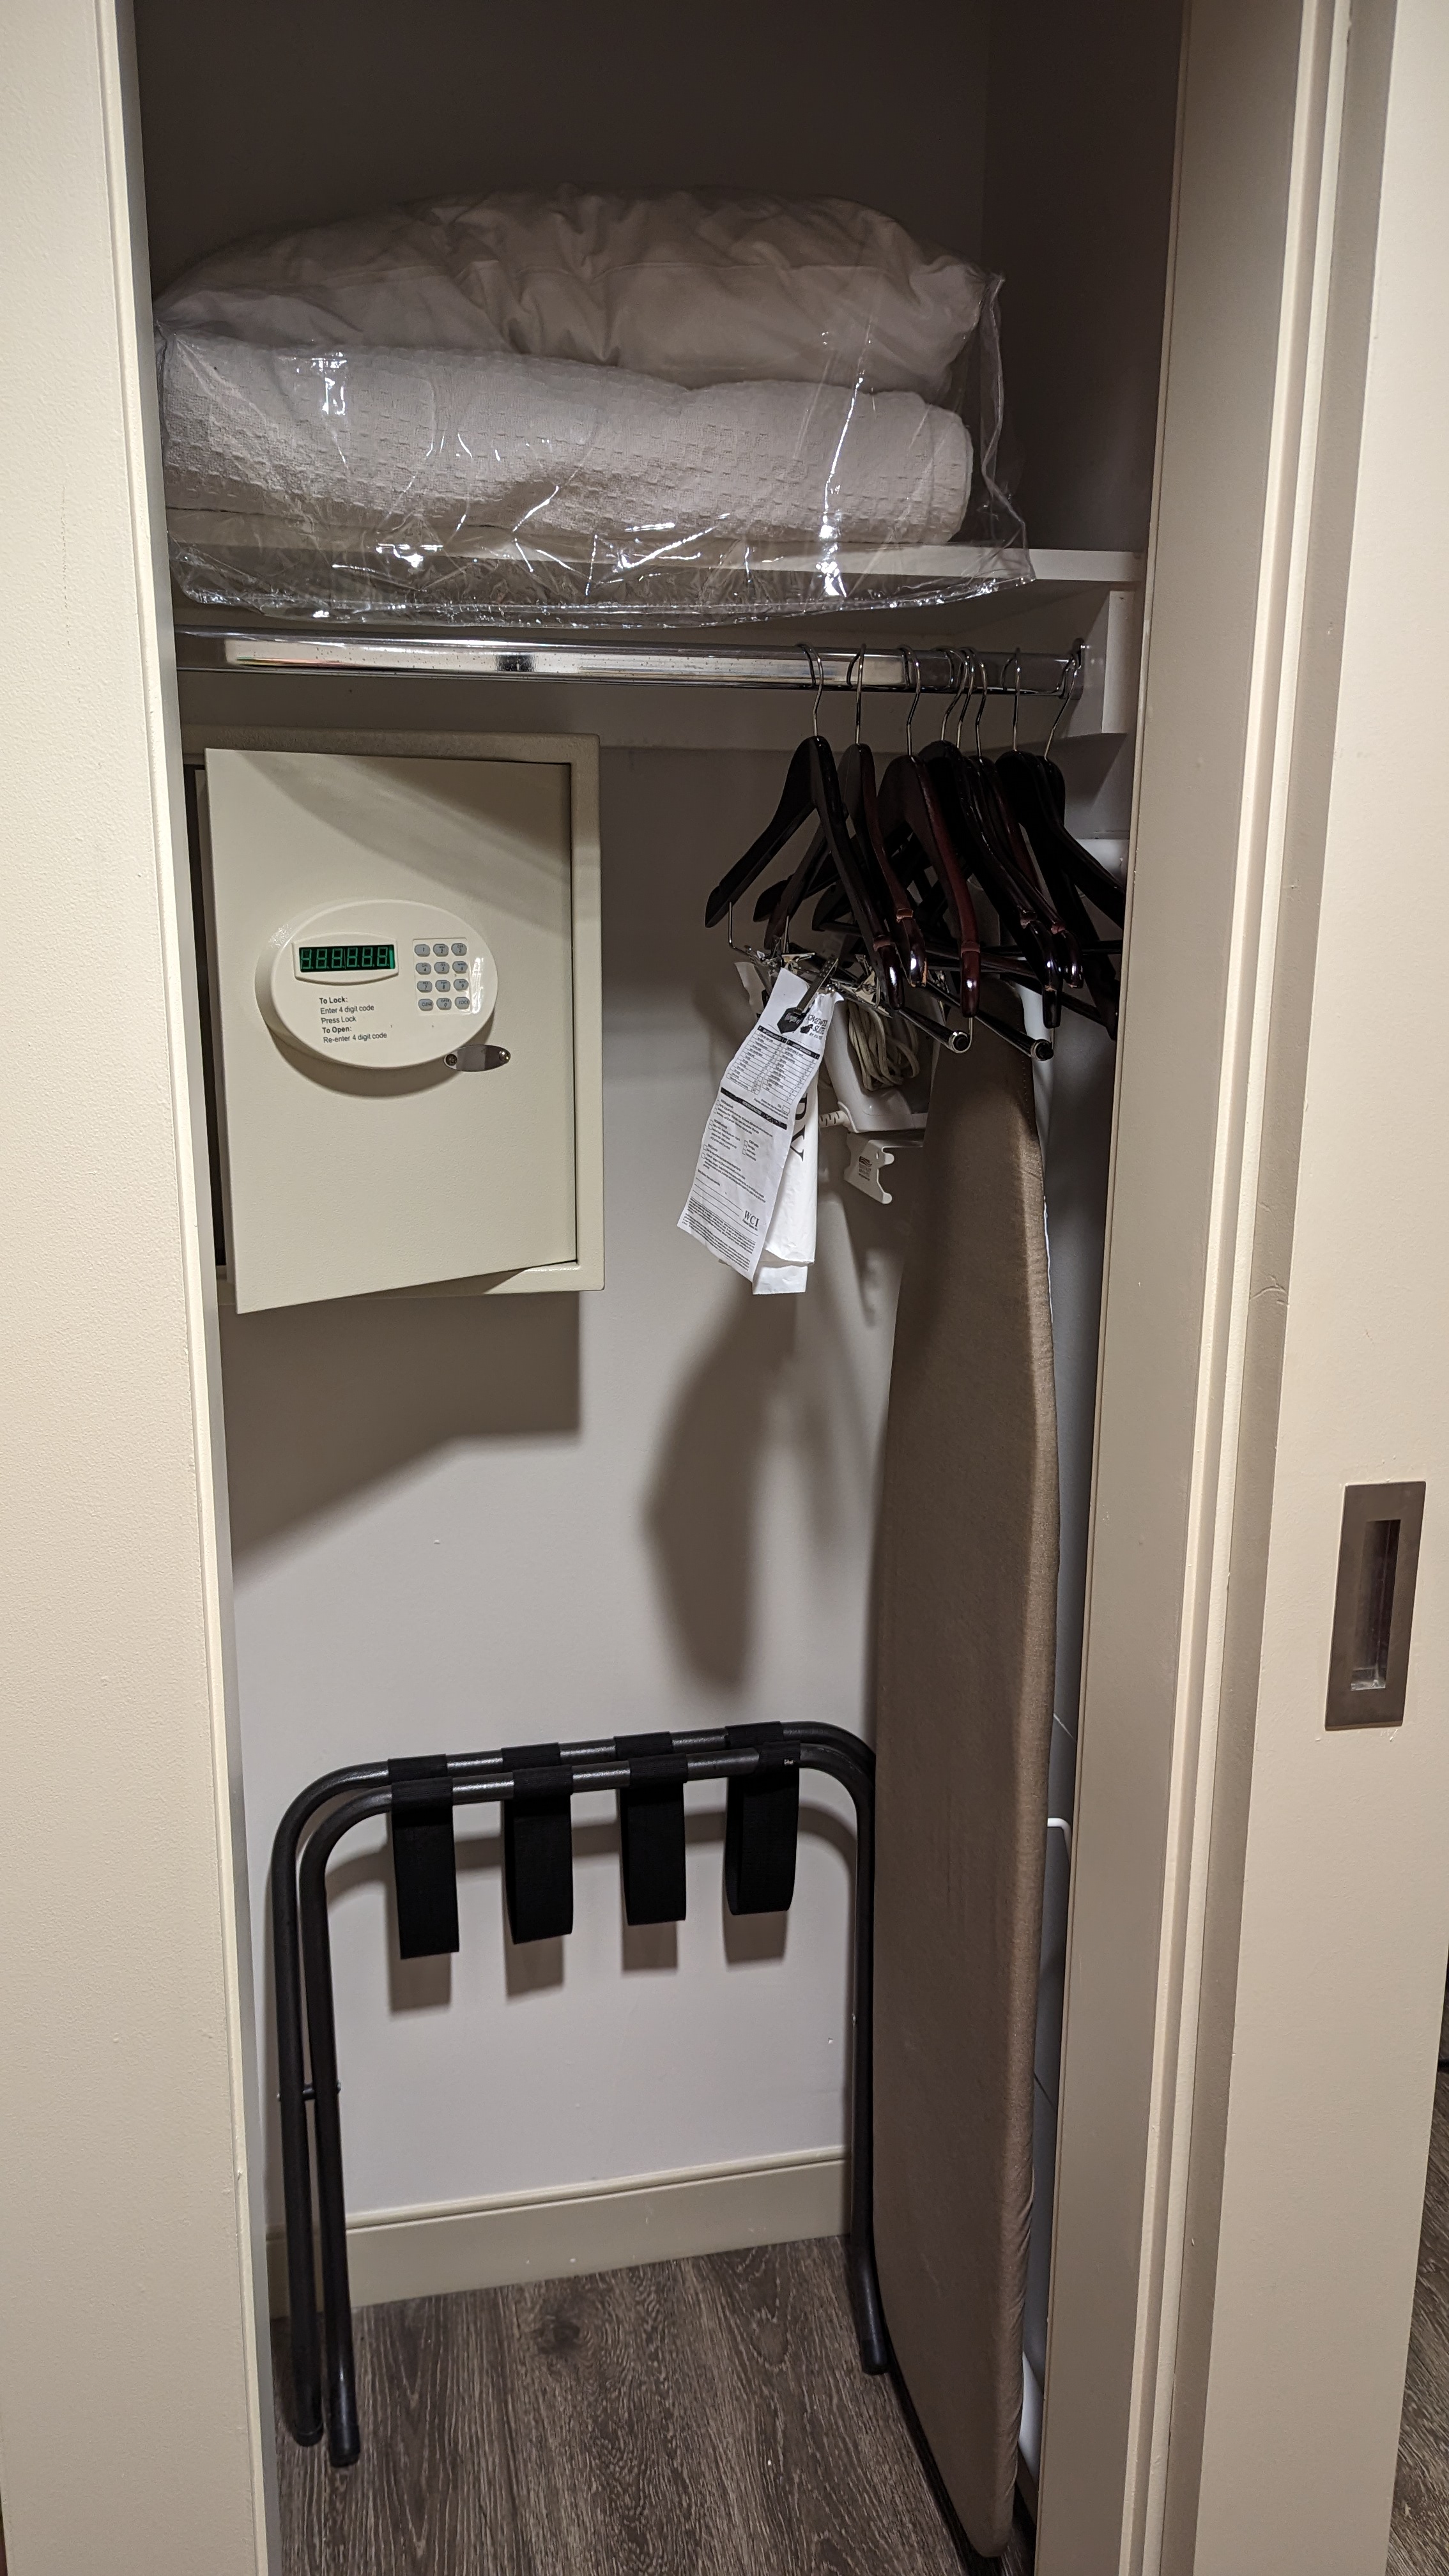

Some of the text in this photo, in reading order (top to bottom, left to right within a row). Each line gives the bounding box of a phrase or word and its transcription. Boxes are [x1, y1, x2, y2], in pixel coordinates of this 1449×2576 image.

[344, 1006, 358, 1014] digit
[332, 1026, 352, 1034] Open:
[358, 1033, 371, 1041] digit
[744, 1210, 760, 1227] WCI
